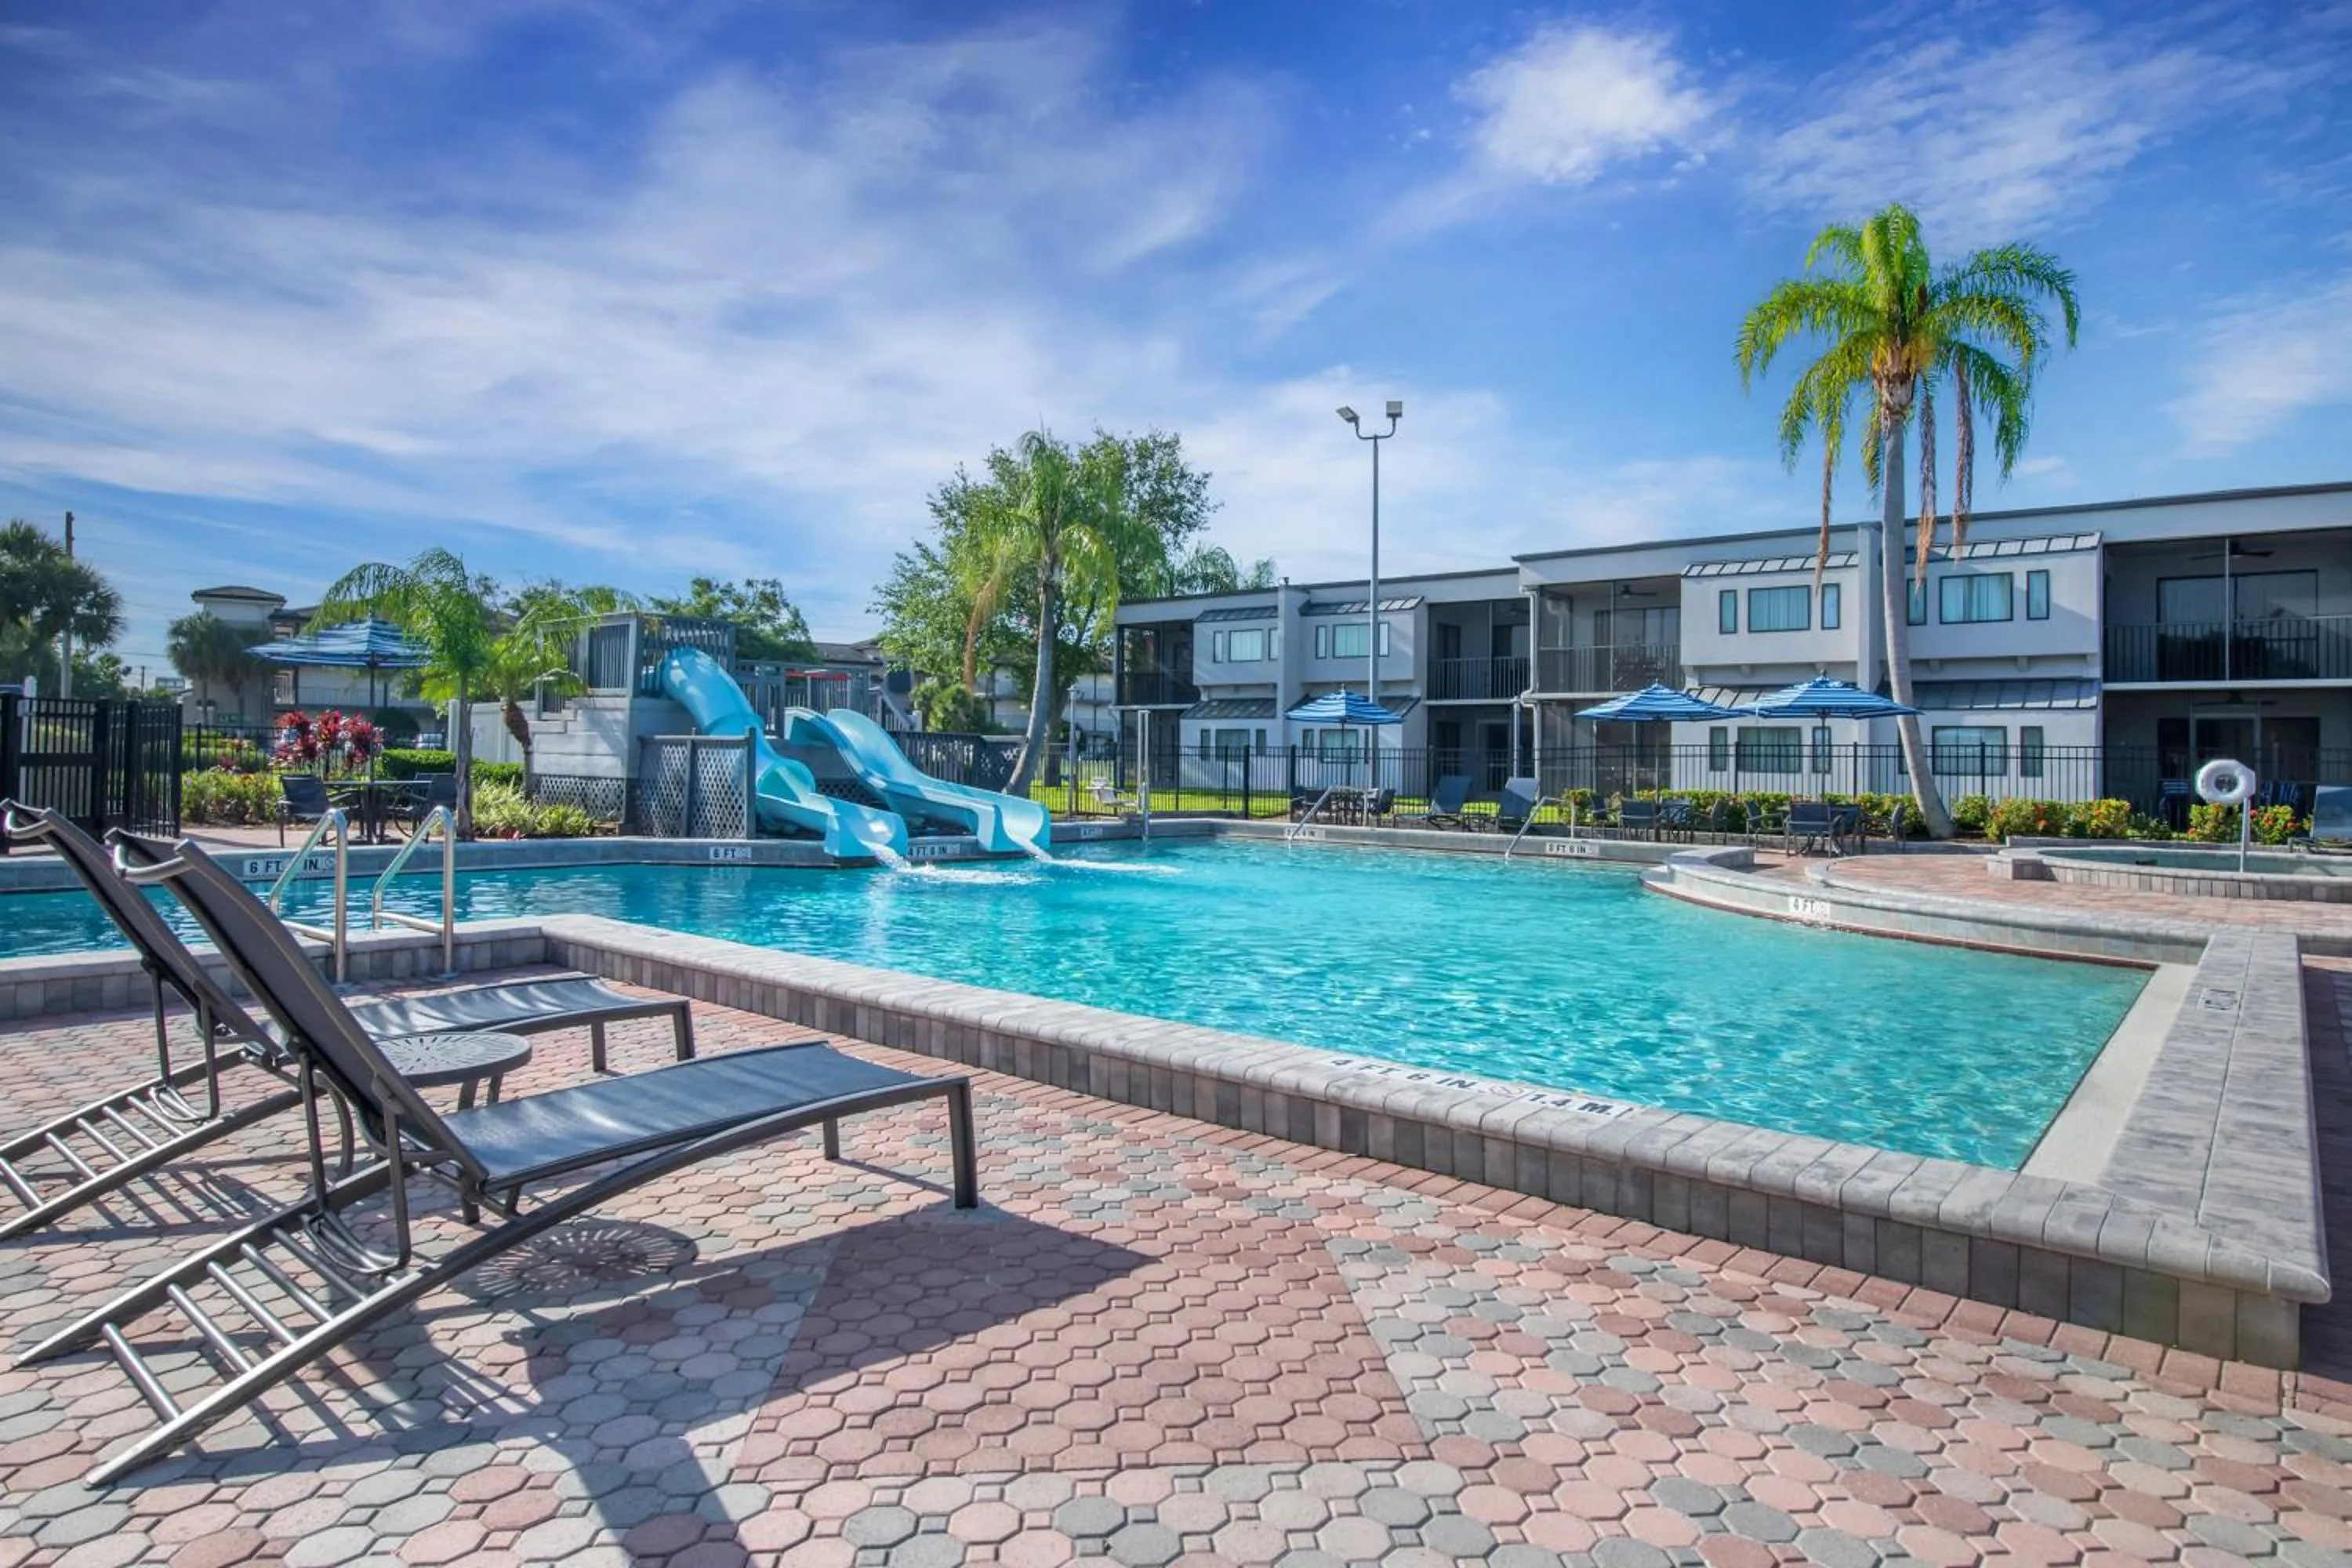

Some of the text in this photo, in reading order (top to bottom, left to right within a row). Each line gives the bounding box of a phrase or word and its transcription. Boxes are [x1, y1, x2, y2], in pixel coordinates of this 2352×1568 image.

[724, 848, 735, 858] FT
[250, 861, 258, 873] 6
[1802, 898, 1815, 914] FT
[1530, 1094, 1572, 1107] 1.4
